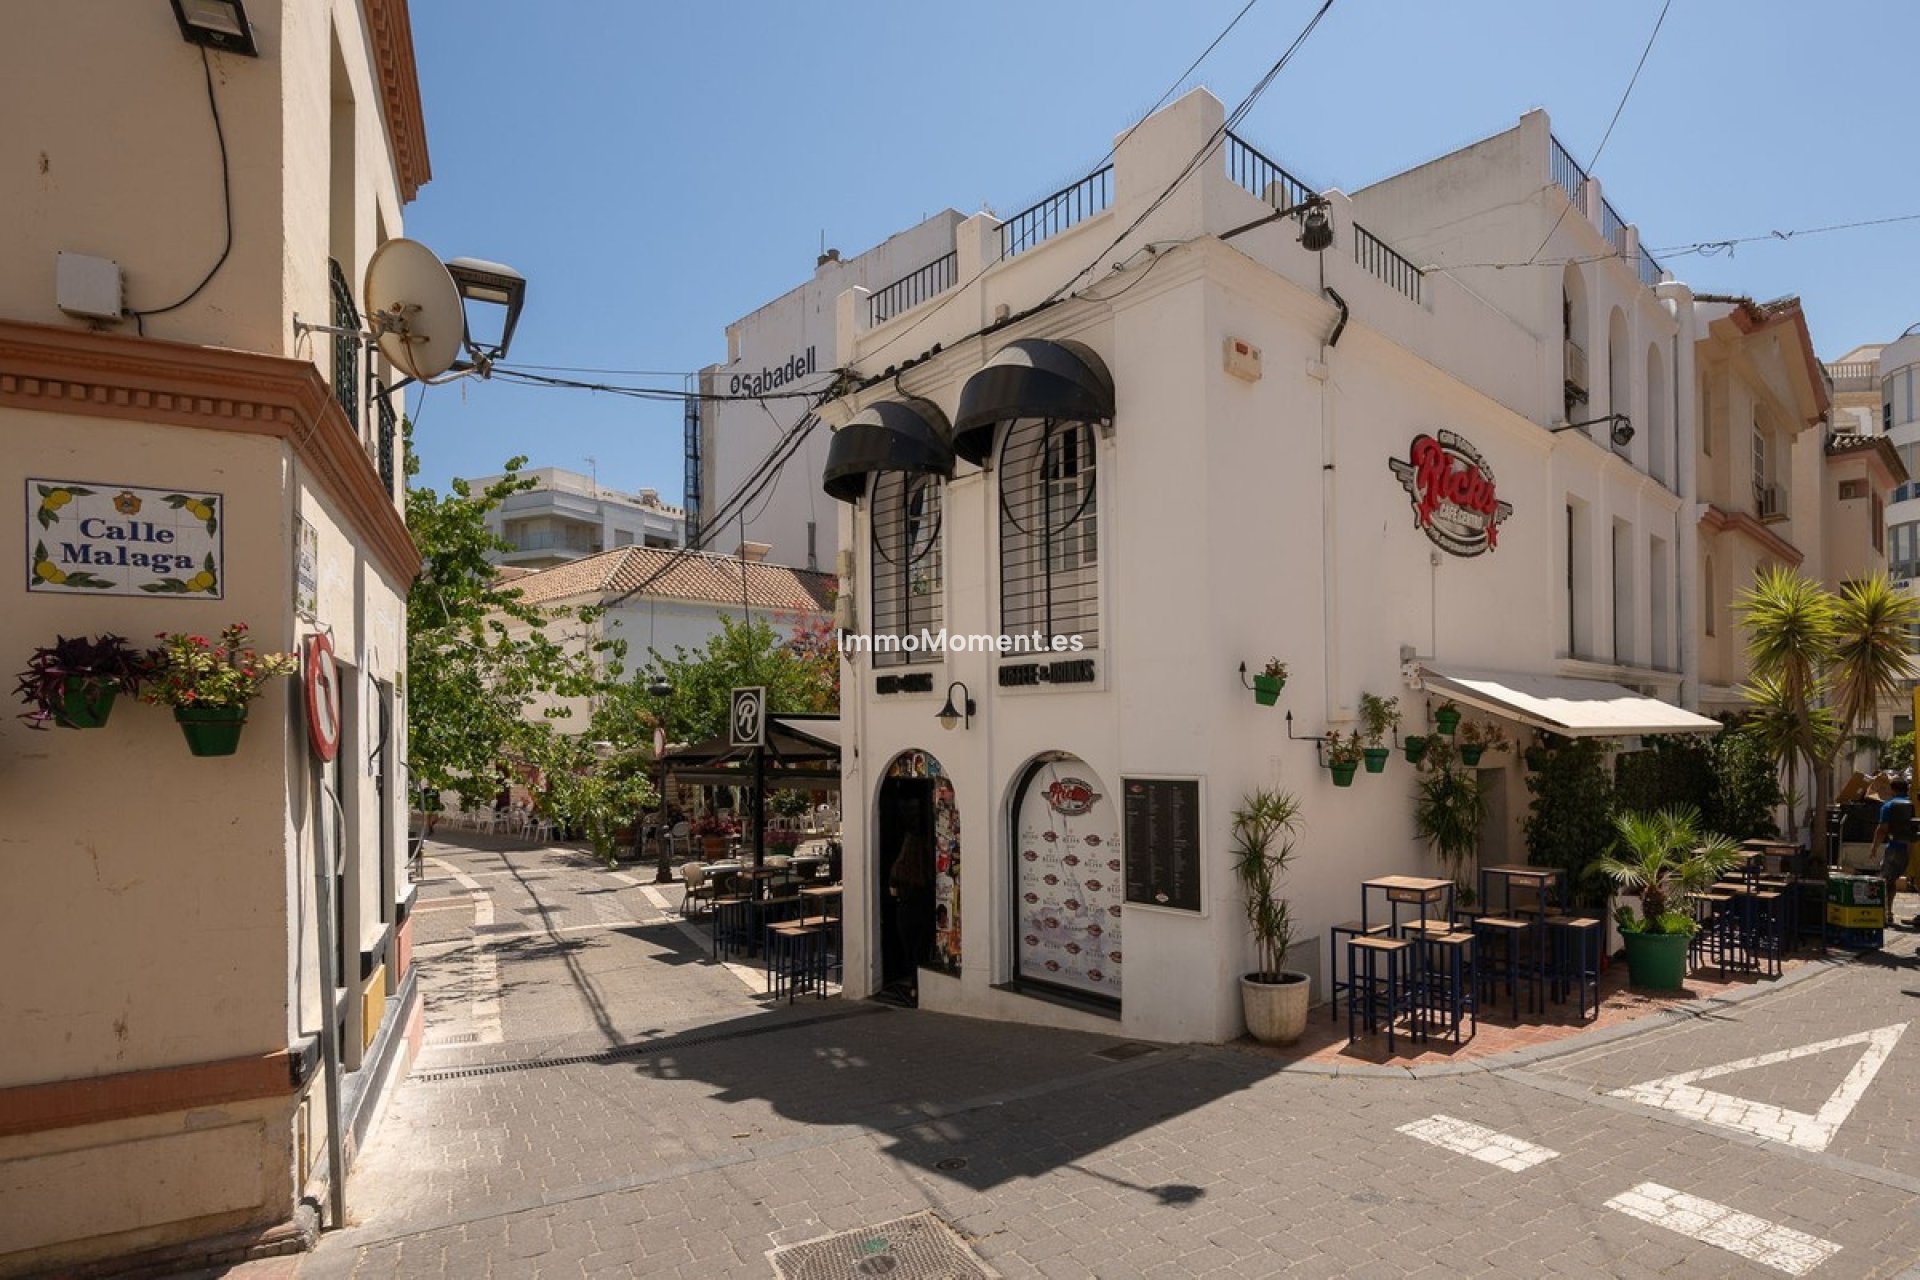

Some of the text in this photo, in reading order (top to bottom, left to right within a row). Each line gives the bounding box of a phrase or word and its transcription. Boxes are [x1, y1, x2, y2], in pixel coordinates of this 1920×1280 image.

[742, 345, 816, 398] Sabadell
[79, 517, 175, 545] Calle
[60, 542, 195, 574] Malaga
[738, 700, 757, 734] R
